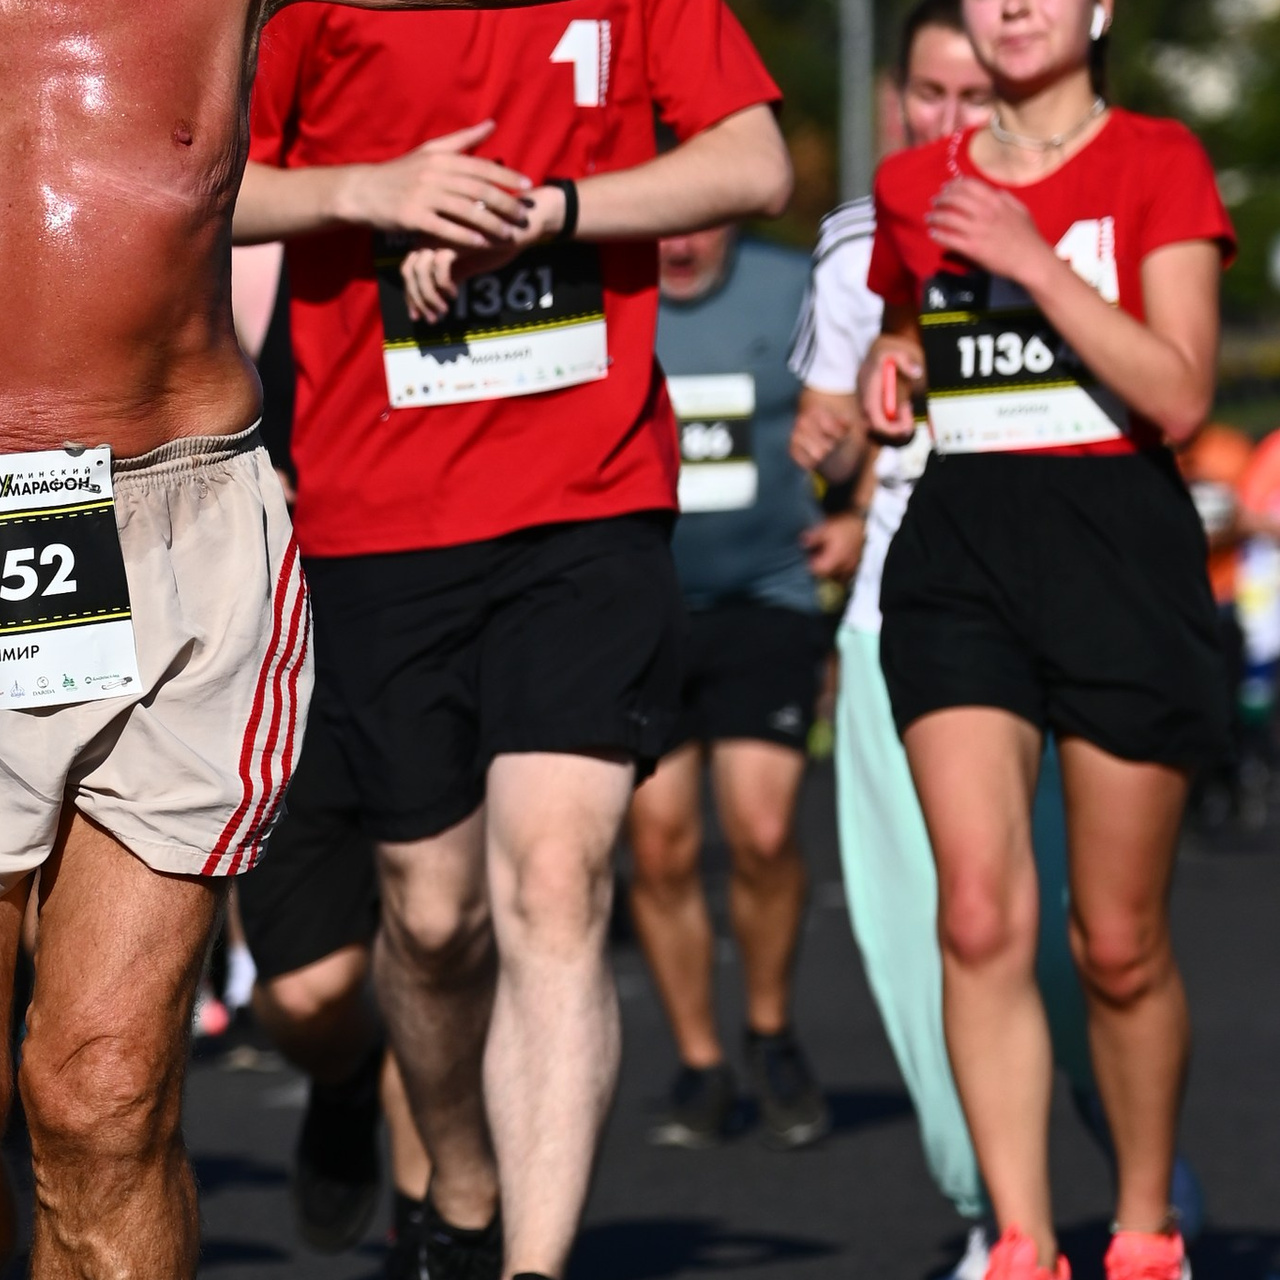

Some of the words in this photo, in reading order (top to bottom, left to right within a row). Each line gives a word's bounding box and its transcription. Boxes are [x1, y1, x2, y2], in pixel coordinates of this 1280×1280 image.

[438, 265, 554, 320] 1361
[957, 331, 1080, 379] 1136
[16, 466, 91, 480] МИНСКИЙ
